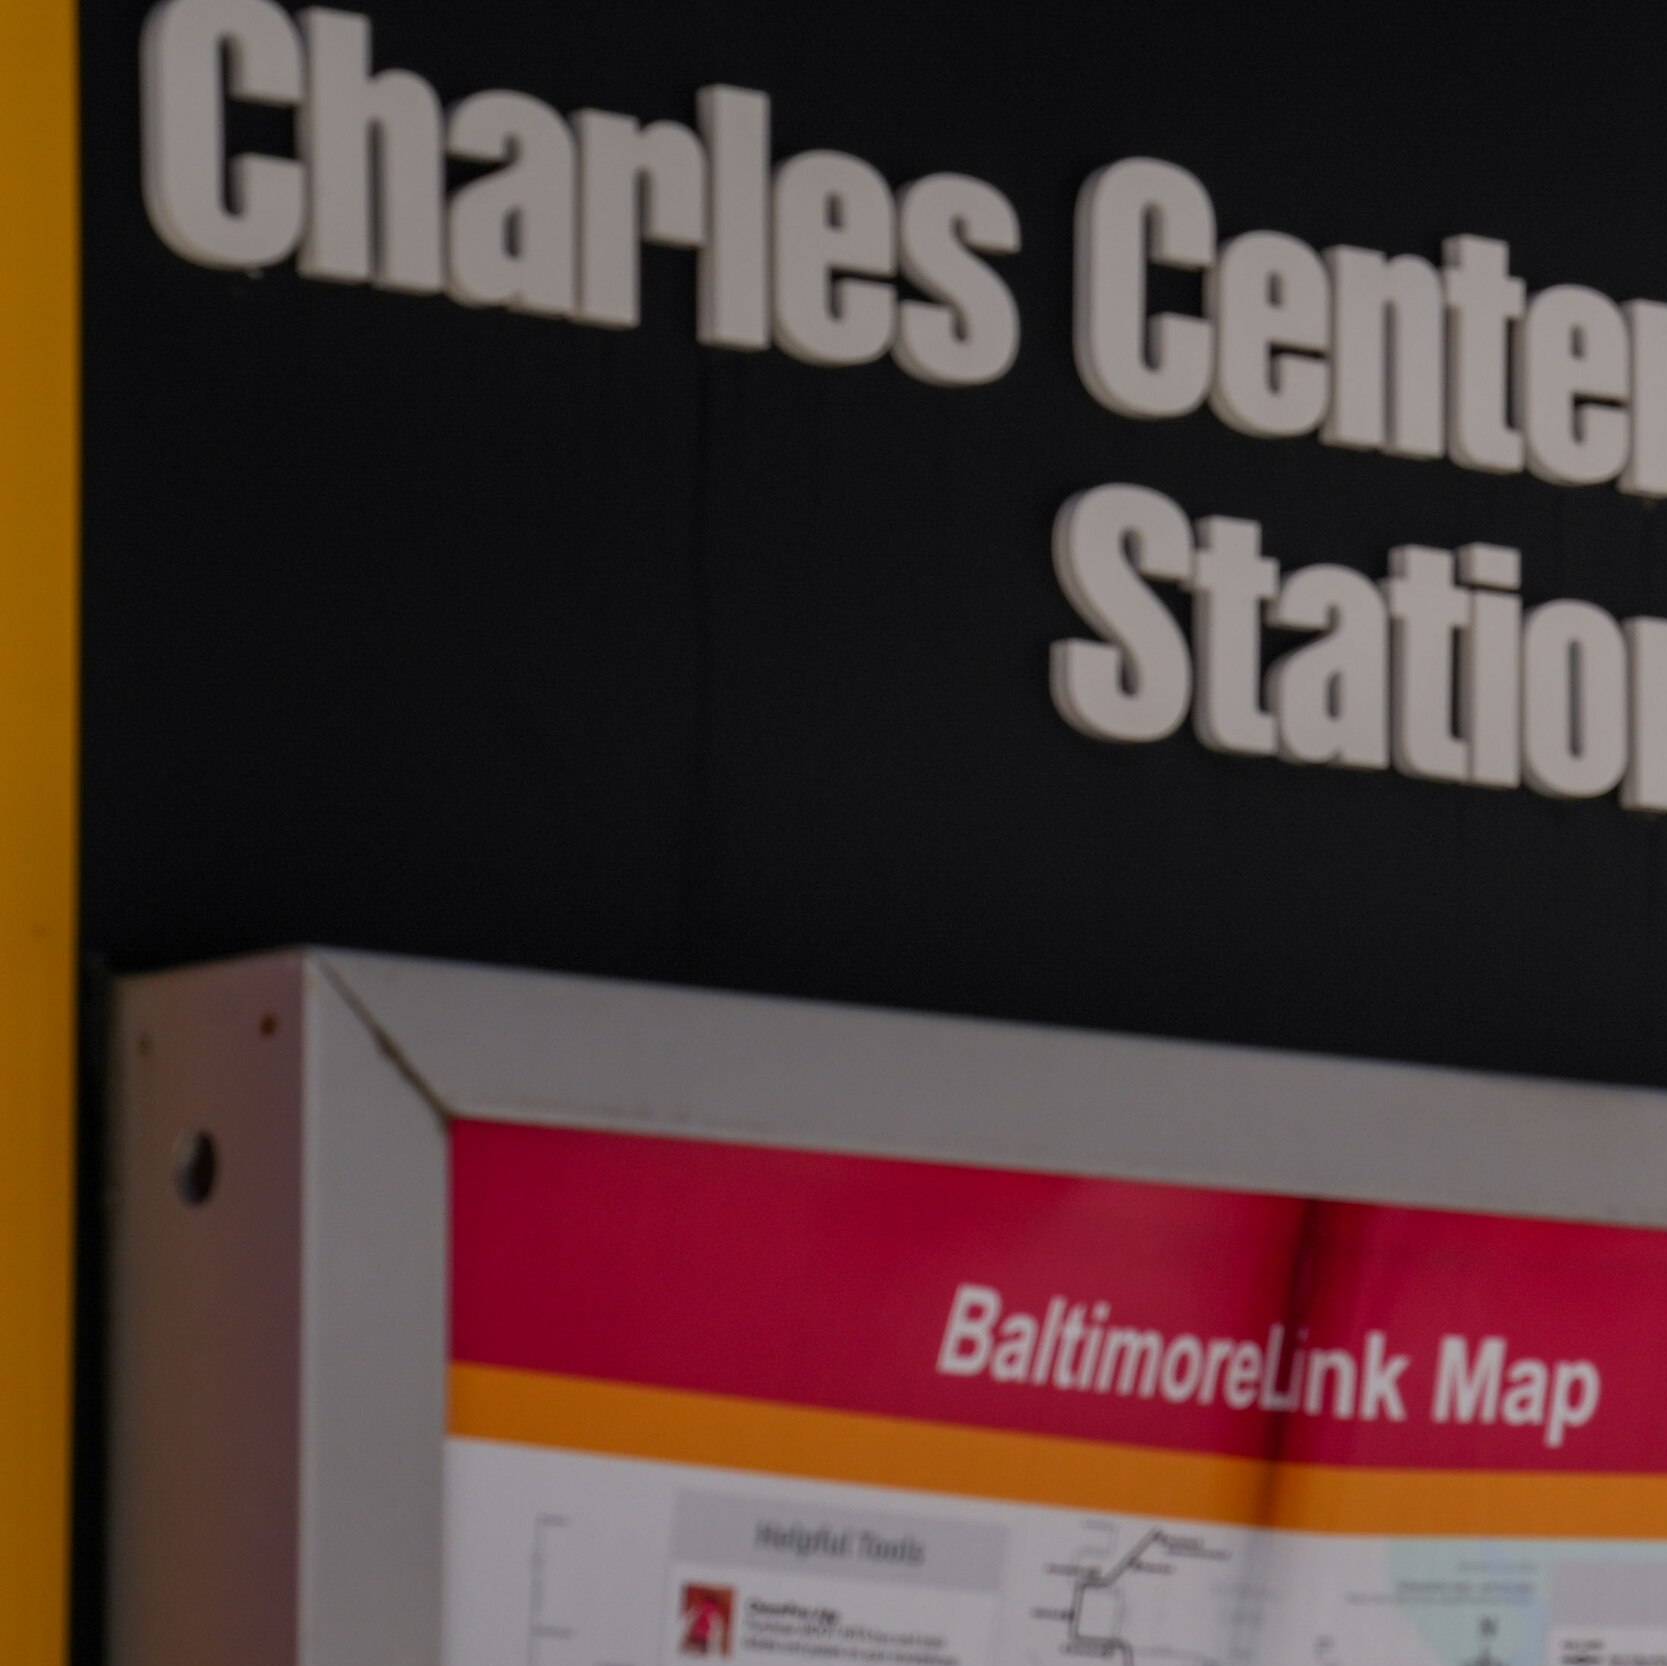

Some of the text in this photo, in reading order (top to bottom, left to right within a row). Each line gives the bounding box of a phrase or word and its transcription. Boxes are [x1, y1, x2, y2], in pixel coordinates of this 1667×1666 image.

[142, 0, 1022, 386] Charles
[935, 1283, 1600, 1448] BaltimoreLink Map
[753, 1519, 926, 1567] Helpful Tools
